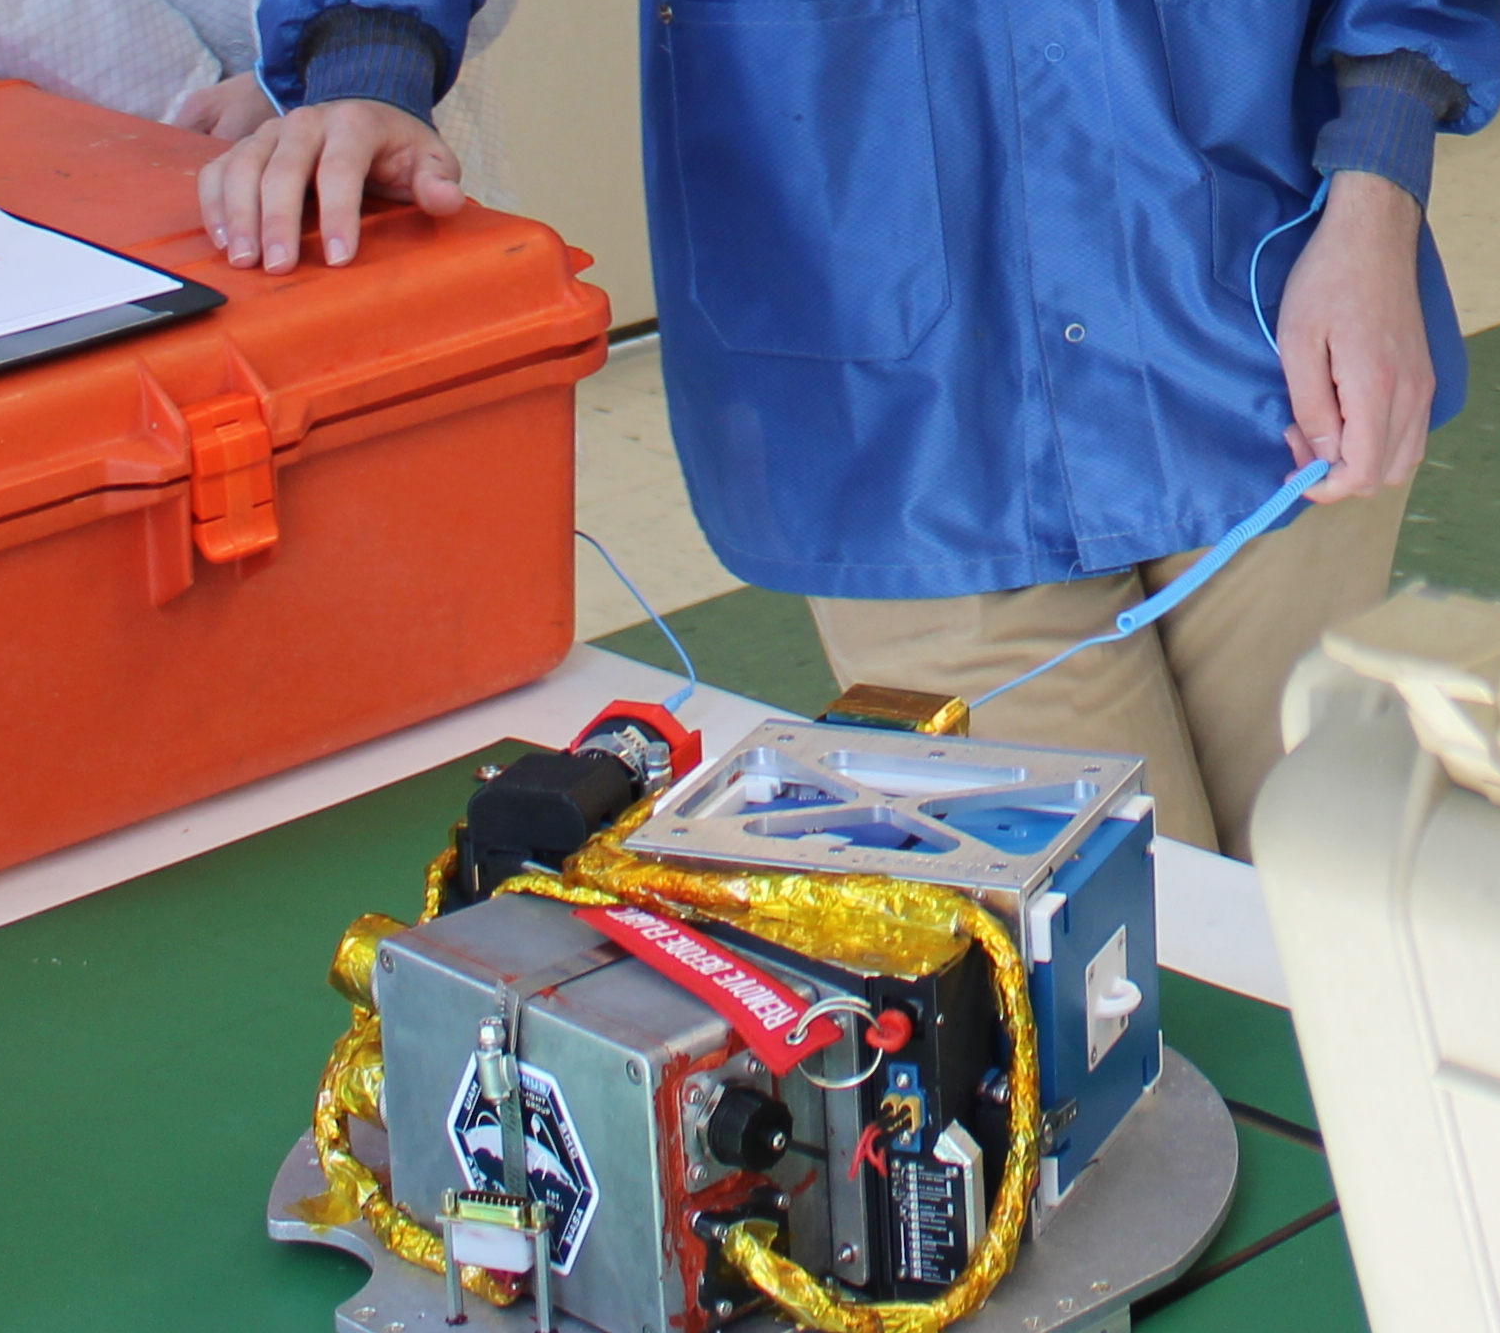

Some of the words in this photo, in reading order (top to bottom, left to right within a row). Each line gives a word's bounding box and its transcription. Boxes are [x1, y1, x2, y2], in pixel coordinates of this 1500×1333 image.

[605, 906, 679, 940] FLIGHT
[656, 935, 734, 976] BEFORE
[712, 969, 799, 1031] REMOVE
[463, 1080, 479, 1111] UAH
[564, 1207, 584, 1244] NASA
